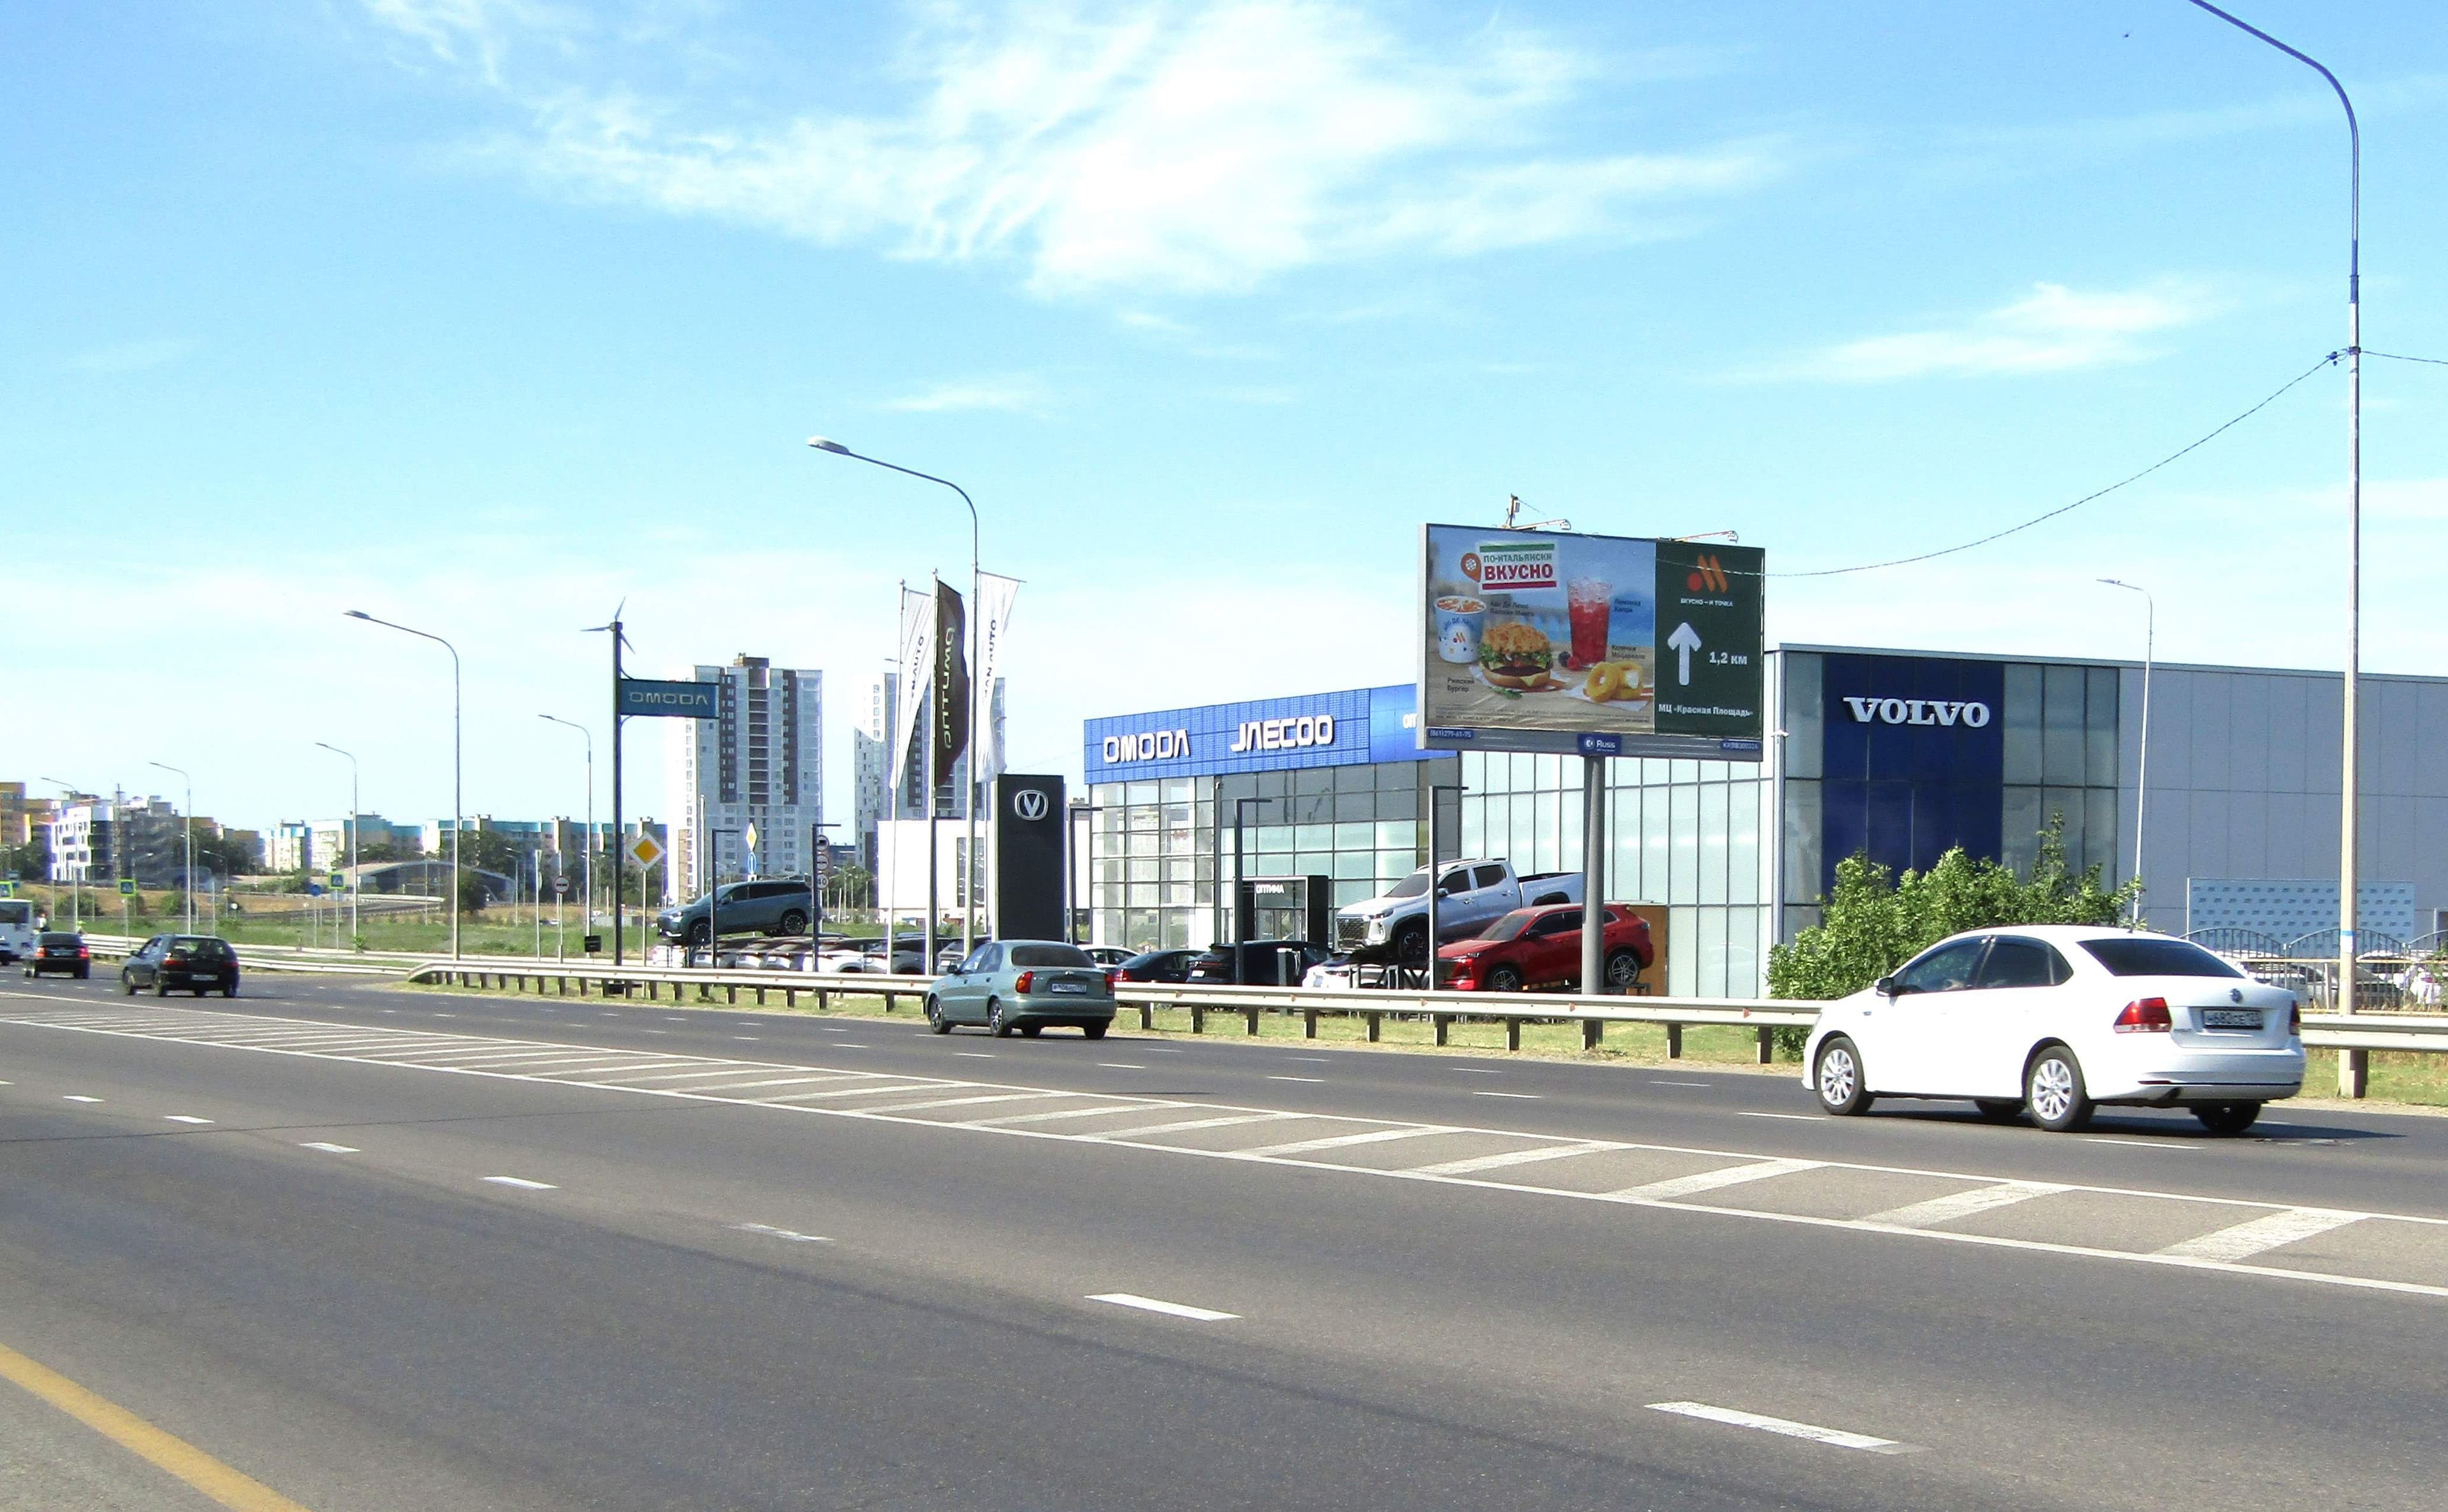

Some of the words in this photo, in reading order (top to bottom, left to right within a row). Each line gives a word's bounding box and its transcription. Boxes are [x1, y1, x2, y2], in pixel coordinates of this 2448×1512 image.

[1483, 553, 1552, 563] ПО-ИТАЛЬЯНСКИ
[1484, 563, 1554, 581] ВКУСНО
[1709, 651, 1728, 665] 1,2
[629, 692, 708, 706] OMODA
[1658, 704, 1672, 714] МЦ
[1843, 697, 1990, 728] VOLVO
[1230, 715, 1334, 752] JAECOO
[1103, 729, 1191, 764] OMODA
[1596, 739, 1616, 748] Russ
[1256, 883, 1285, 894] ОПТИМА
